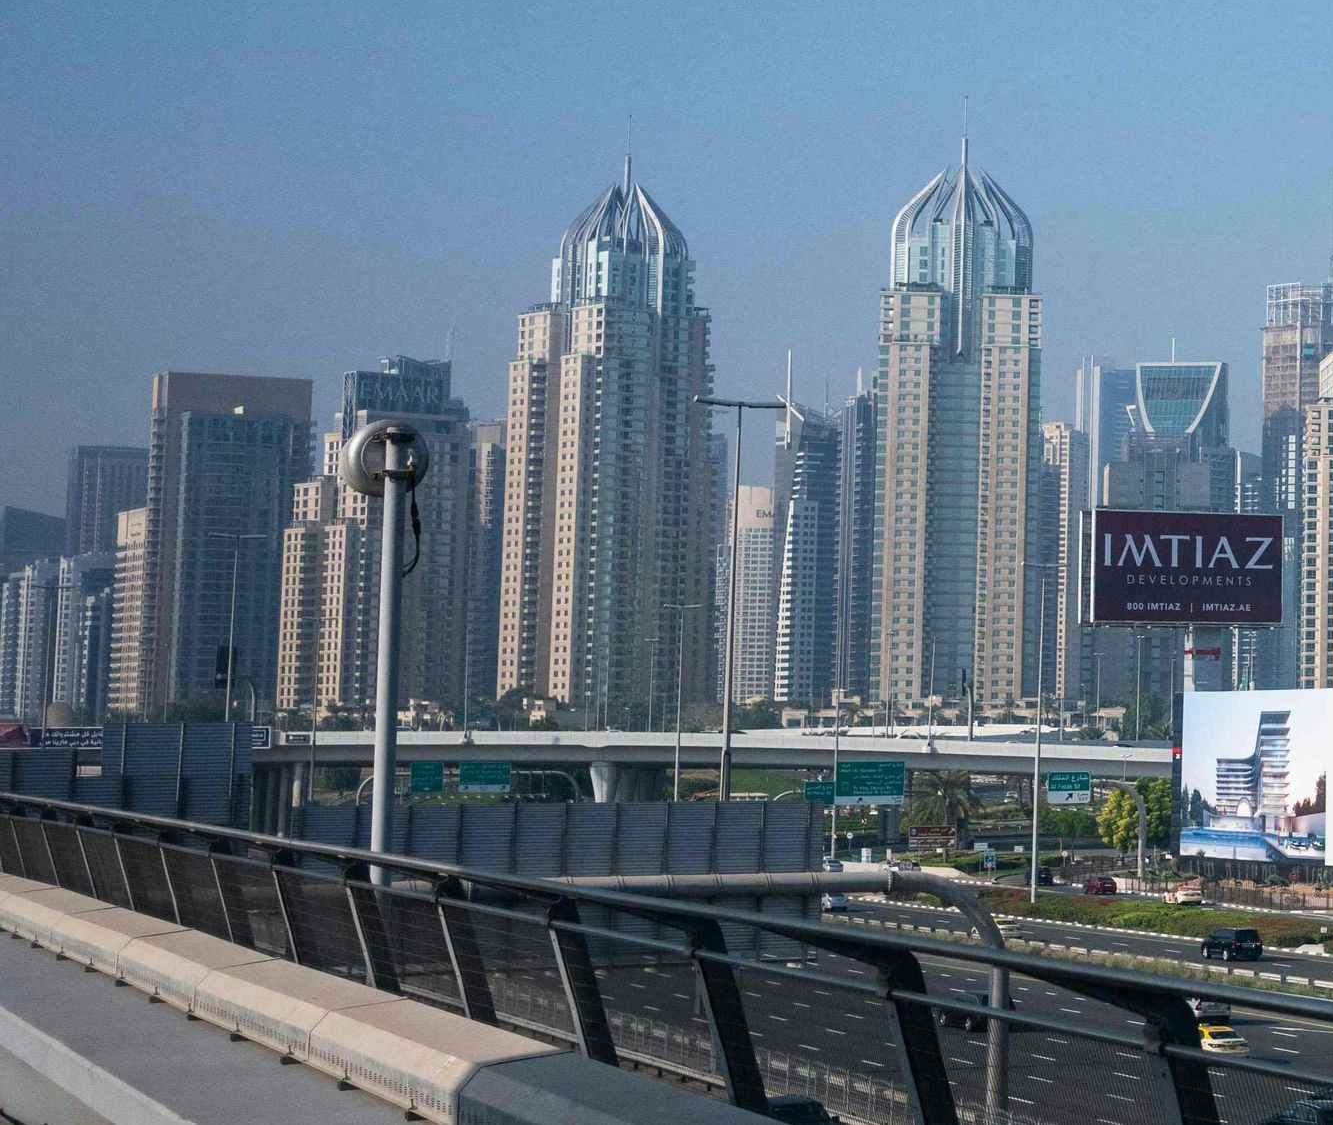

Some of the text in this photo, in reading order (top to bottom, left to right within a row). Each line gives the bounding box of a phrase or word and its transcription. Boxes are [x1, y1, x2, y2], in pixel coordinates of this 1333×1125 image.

[360, 380, 440, 404] EMAAR
[1104, 533, 1274, 570] IMTIAZ
[1126, 574, 1252, 586] DEVELOPMENTS
[1126, 602, 1251, 612] 800 IMTIAZ IMTIAZ.AE
